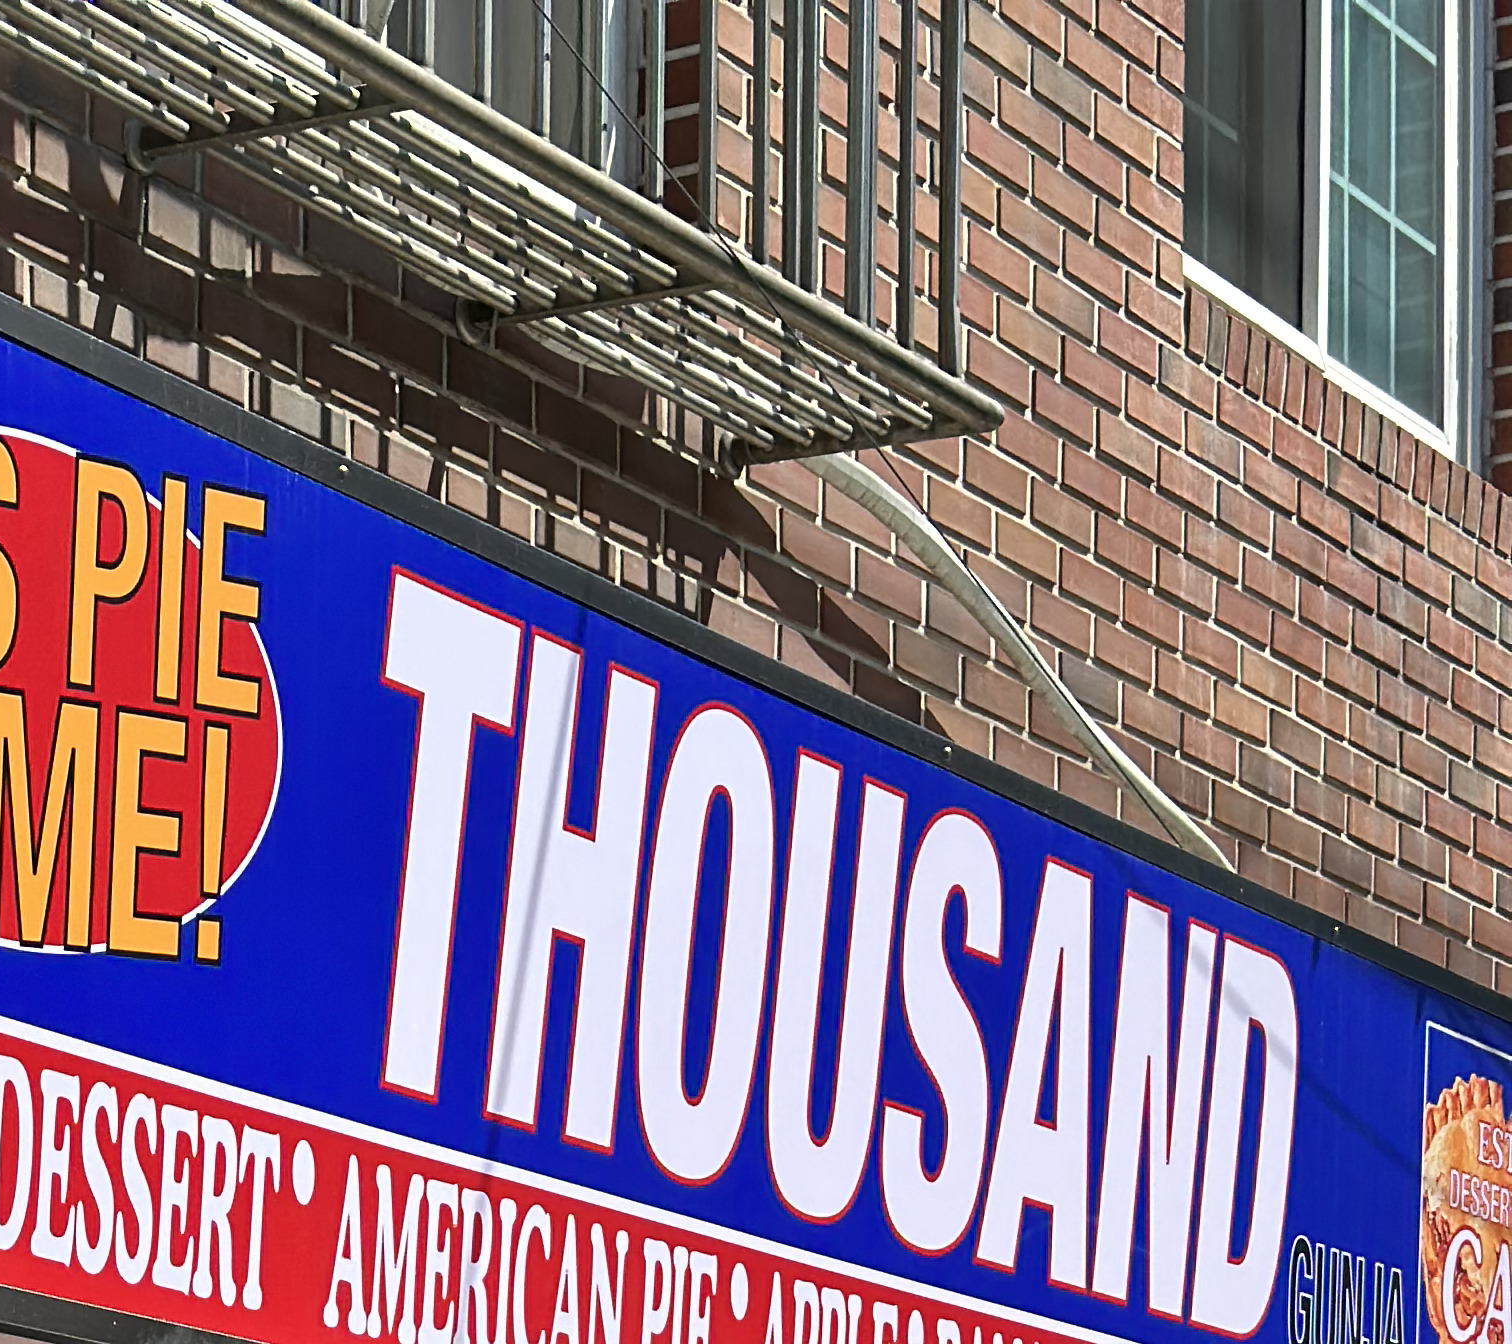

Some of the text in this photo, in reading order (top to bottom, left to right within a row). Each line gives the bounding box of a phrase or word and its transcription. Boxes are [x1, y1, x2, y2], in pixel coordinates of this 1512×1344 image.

[65, 453, 267, 720] PIE
[379, 564, 1300, 1340] THOUSAND
[1450, 1168, 1512, 1228] DESSER
